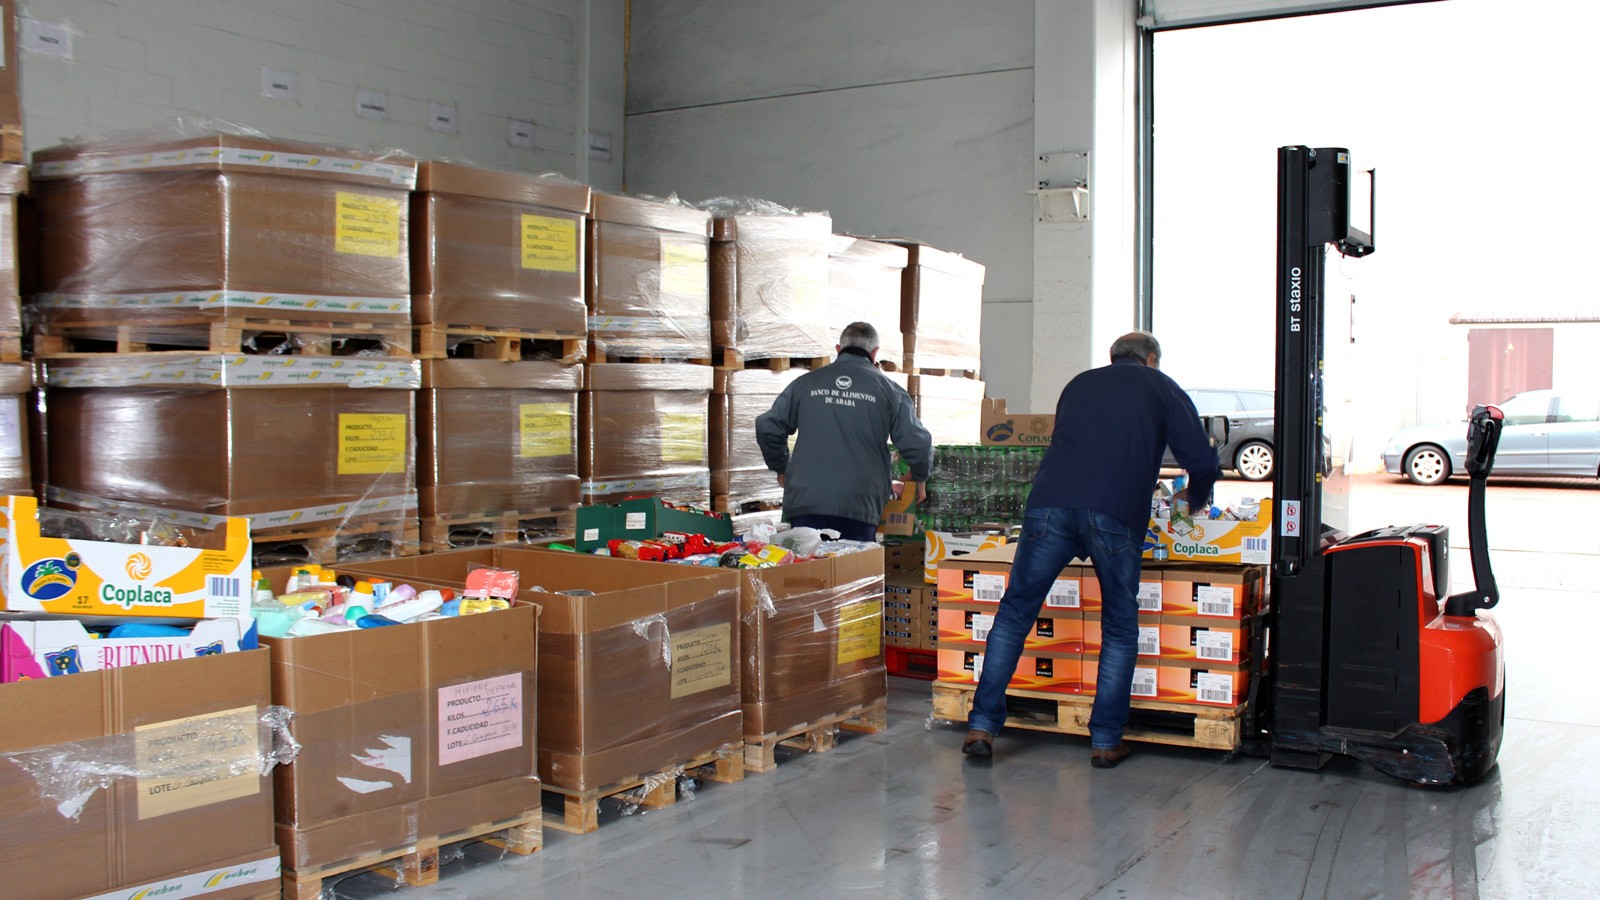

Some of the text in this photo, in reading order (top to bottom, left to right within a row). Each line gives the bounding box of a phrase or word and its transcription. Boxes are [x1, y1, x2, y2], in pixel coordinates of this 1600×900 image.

[1290, 316, 1300, 332] BT
[810, 388, 877, 403] BANCO DE ALIMENTOS
[825, 396, 855, 407] DE ARABA
[1174, 543, 1219, 555] Coplaca
[77, 596, 88, 604] 17
[102, 584, 172, 606] Coplaca
[677, 640, 702, 651] PRODUCTO
[676, 678, 688, 686] LOTE
[447, 695, 481, 708] PRODUCTO
[447, 712, 465, 722] KILOS
[447, 721, 489, 736] F.CADUCIDAD
[148, 731, 198, 748] PRODUCTO
[447, 740, 463, 750] LOTE
[149, 783, 171, 795] LOTE
